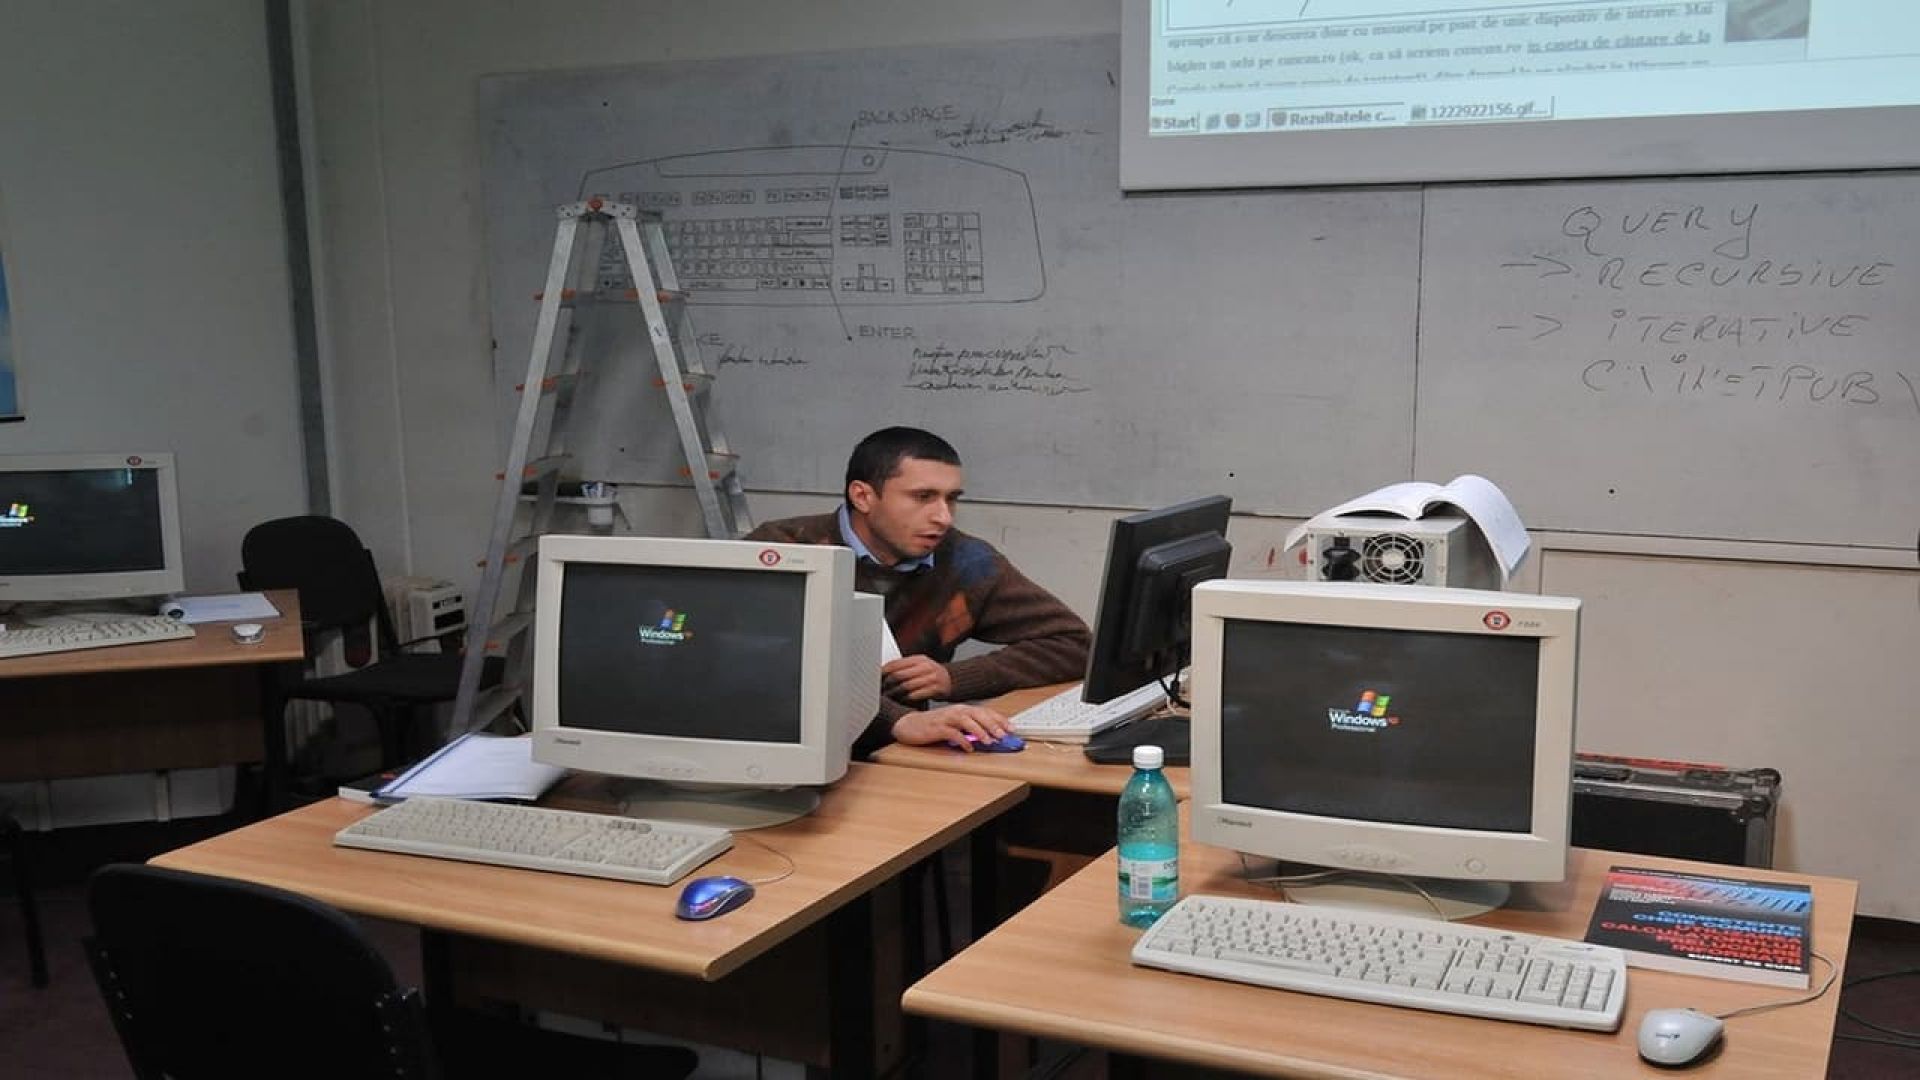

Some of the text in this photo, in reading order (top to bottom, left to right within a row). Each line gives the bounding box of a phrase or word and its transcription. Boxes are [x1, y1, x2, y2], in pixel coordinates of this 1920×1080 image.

[1164, 116, 1196, 129] Start
[1289, 110, 1371, 127] Rezultatele
[1562, 203, 1759, 260] QUERY
[859, 325, 915, 339] ENTER
[639, 627, 685, 640] Windows
[1328, 709, 1388, 727] Windows
